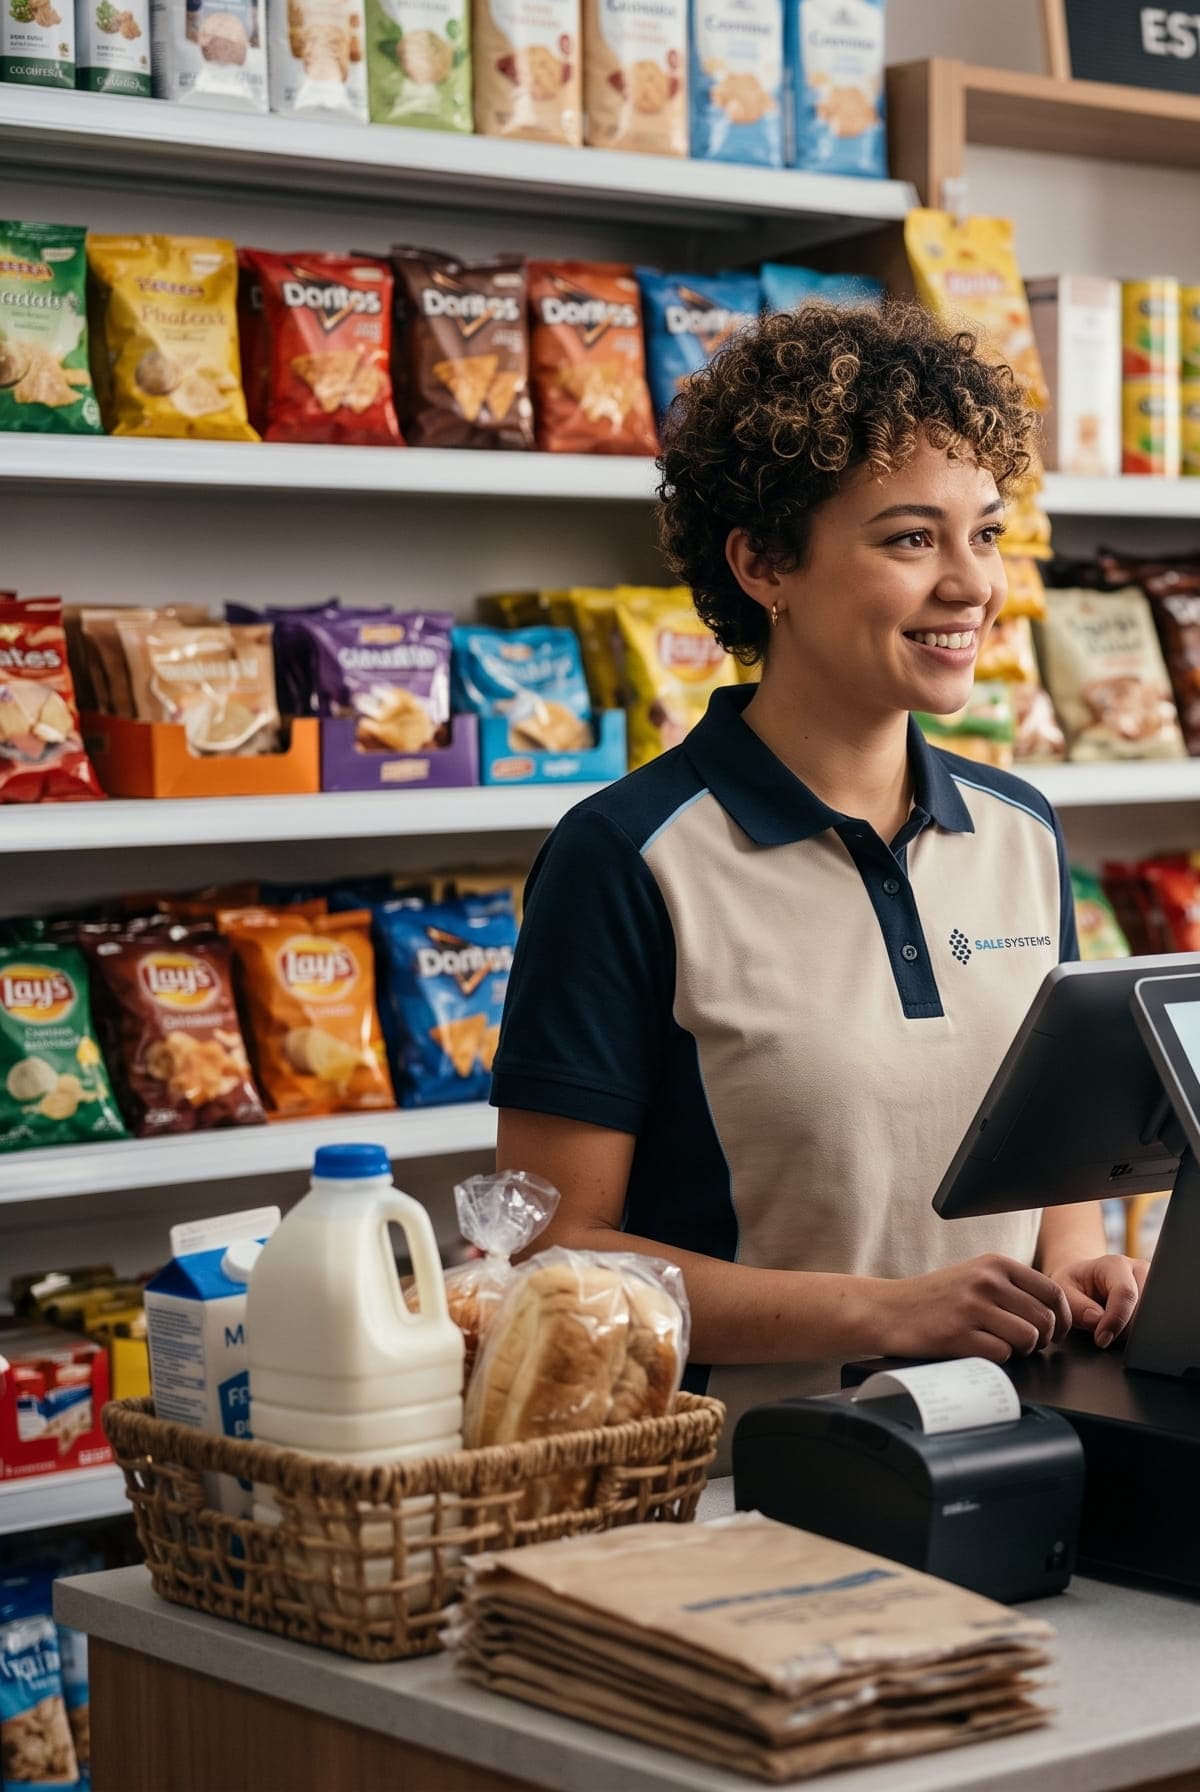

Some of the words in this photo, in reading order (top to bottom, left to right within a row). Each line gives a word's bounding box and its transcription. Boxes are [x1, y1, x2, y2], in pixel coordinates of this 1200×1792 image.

[284, 281, 382, 314] Doritos
[422, 288, 519, 322] Doritos
[540, 297, 638, 328] Doritos
[974, 935, 1052, 950] SALESYSTEMS
